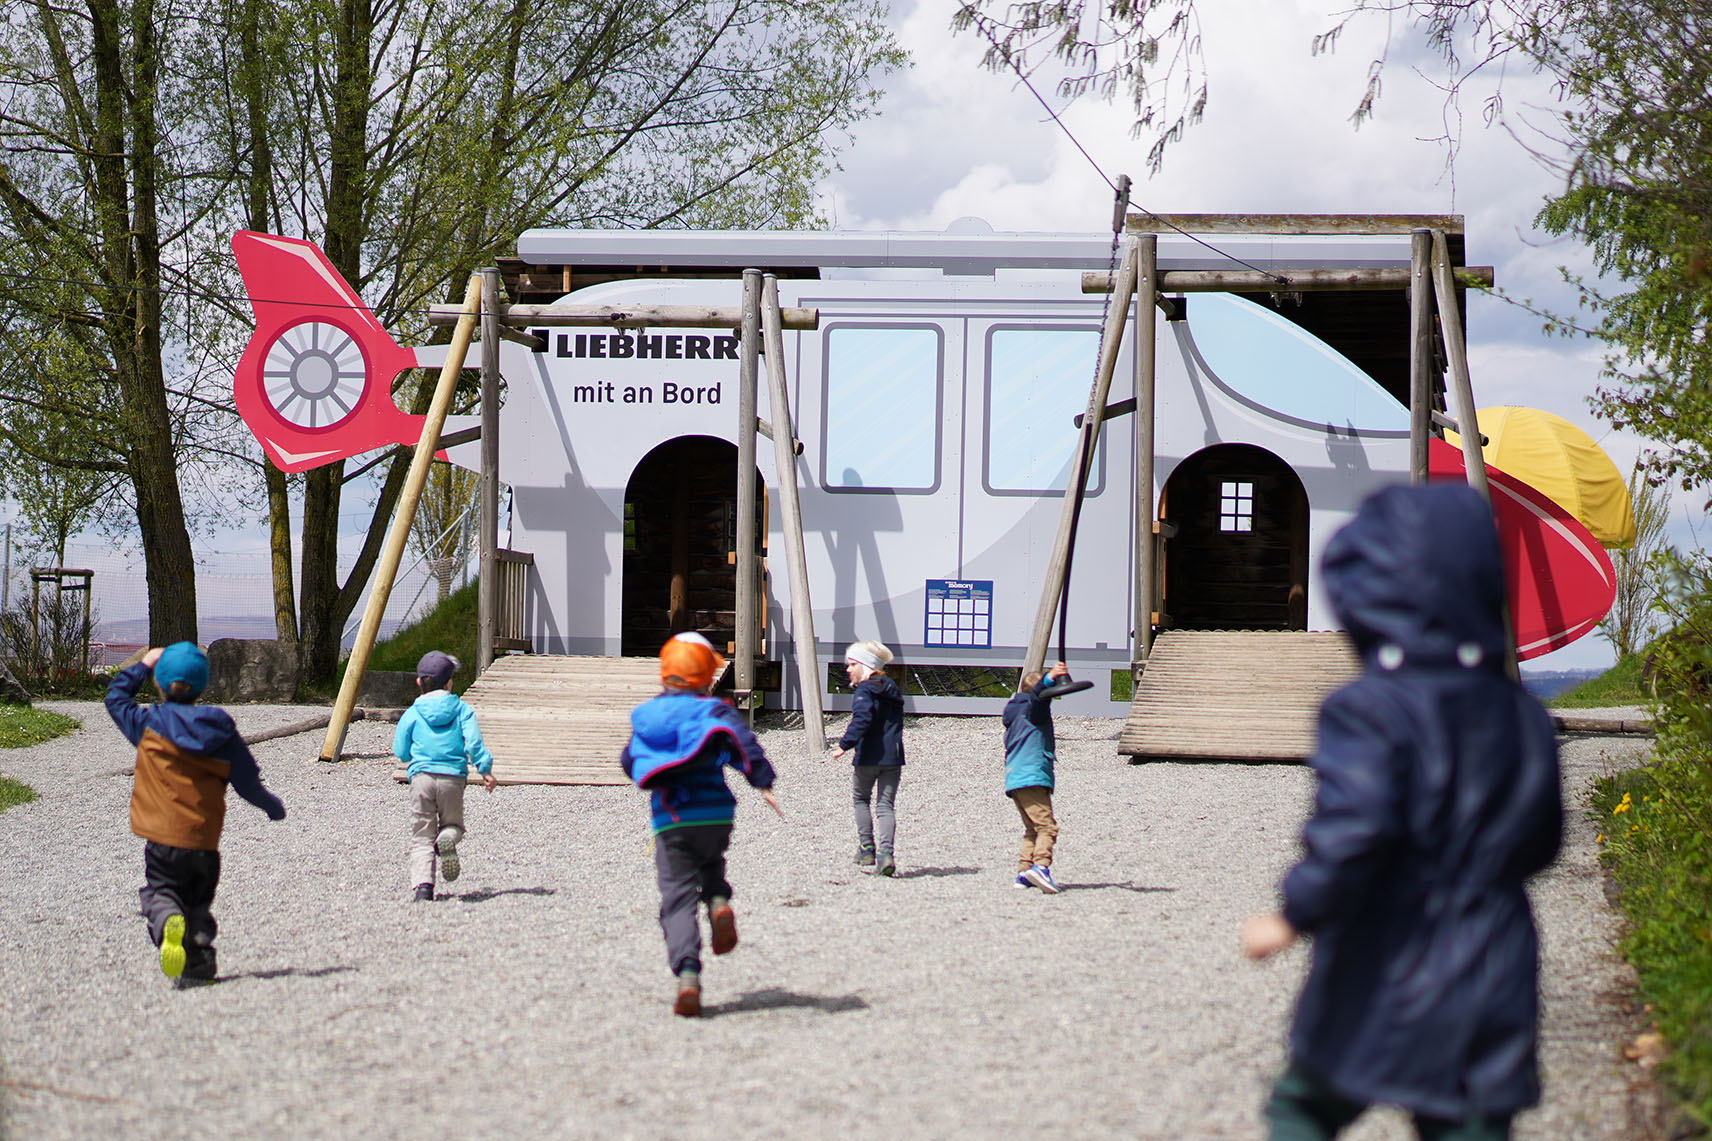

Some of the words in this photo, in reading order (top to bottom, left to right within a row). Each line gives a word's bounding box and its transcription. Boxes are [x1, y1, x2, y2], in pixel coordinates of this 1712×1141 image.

[557, 334, 740, 359] LIEBHERR
[574, 381, 615, 403] mit
[623, 385, 653, 403] an
[663, 382, 721, 404] Bord
